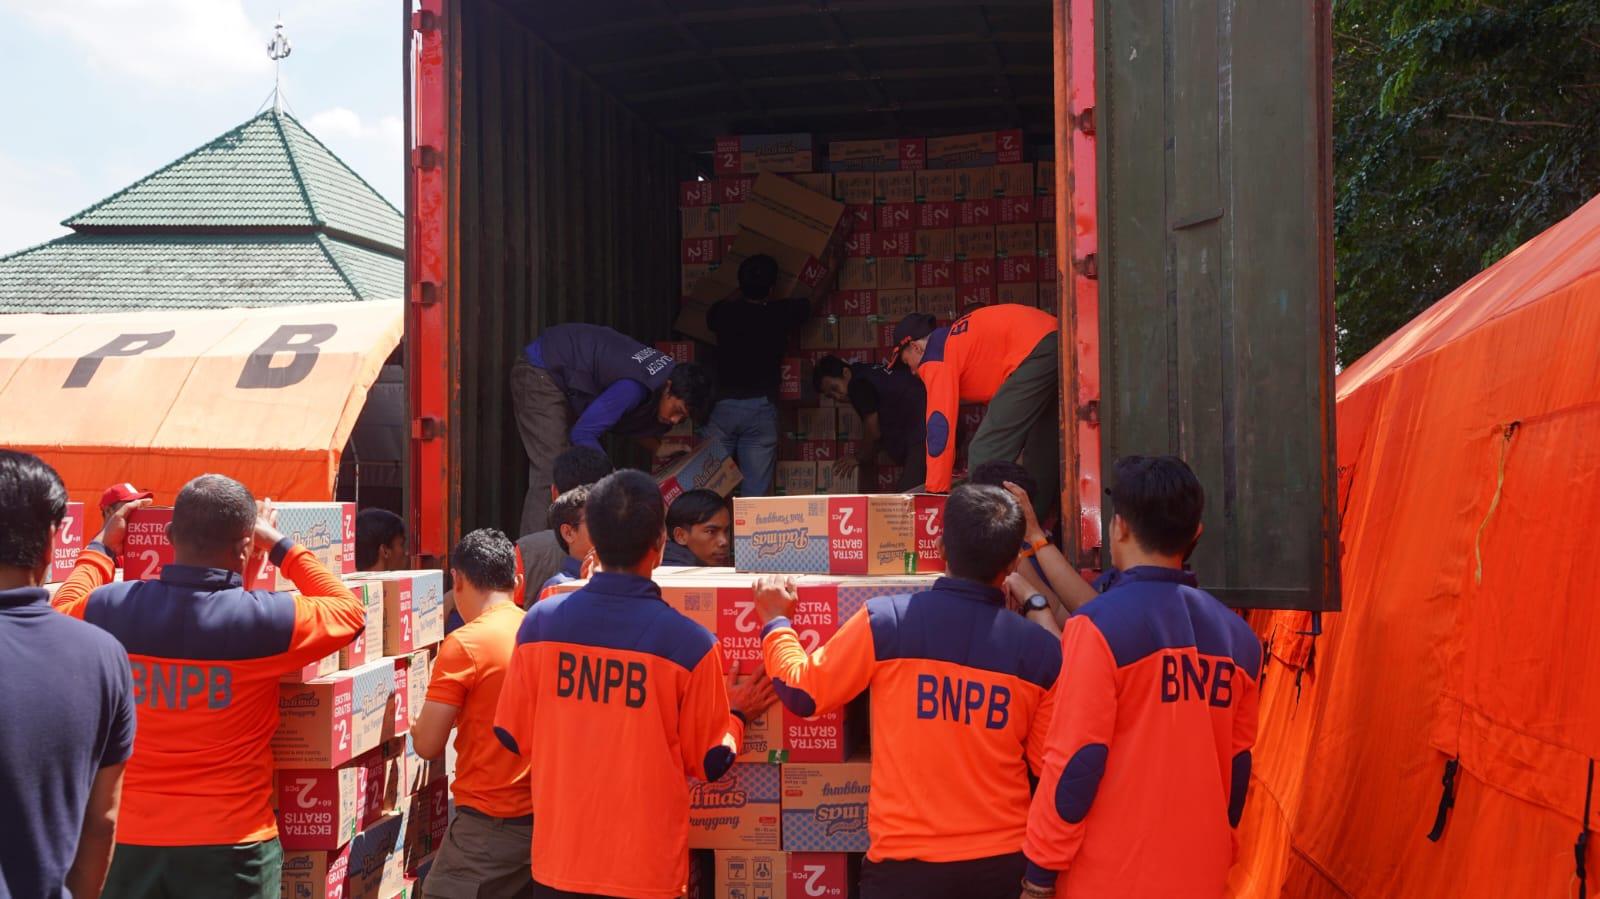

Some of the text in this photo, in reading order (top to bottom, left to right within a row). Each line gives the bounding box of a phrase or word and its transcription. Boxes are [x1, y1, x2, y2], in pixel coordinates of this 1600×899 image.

[839, 507, 853, 535] 2
[925, 508, 938, 535] 2
[61, 517, 73, 544] 2
[128, 535, 170, 545] GRATIS
[751, 526, 808, 553] Padimas
[833, 539, 863, 549] GRATIS
[918, 540, 936, 549] ATIS
[833, 550, 864, 559] EKSTRA
[918, 551, 941, 559] STRA
[55, 560, 76, 569] STRA
[140, 550, 160, 580] 2
[796, 602, 832, 612] STRA
[734, 602, 757, 632] 2
[792, 614, 833, 625] RATIS
[403, 614, 410, 641] 2
[723, 637, 760, 648] RATIS
[723, 650, 764, 660] KSTRA
[130, 662, 233, 710] BNPB
[557, 651, 648, 709] BNPB
[395, 693, 403, 720] 2
[917, 674, 1011, 730] BNPB
[339, 720, 347, 751] 2
[789, 726, 837, 737] GRATIS
[789, 738, 838, 749] EKSTRA
[295, 778, 318, 808] 2
[285, 812, 332, 823] GRATIS
[689, 816, 740, 830] anggang
[285, 824, 332, 835] EKSTRA
[803, 865, 826, 896] 2
